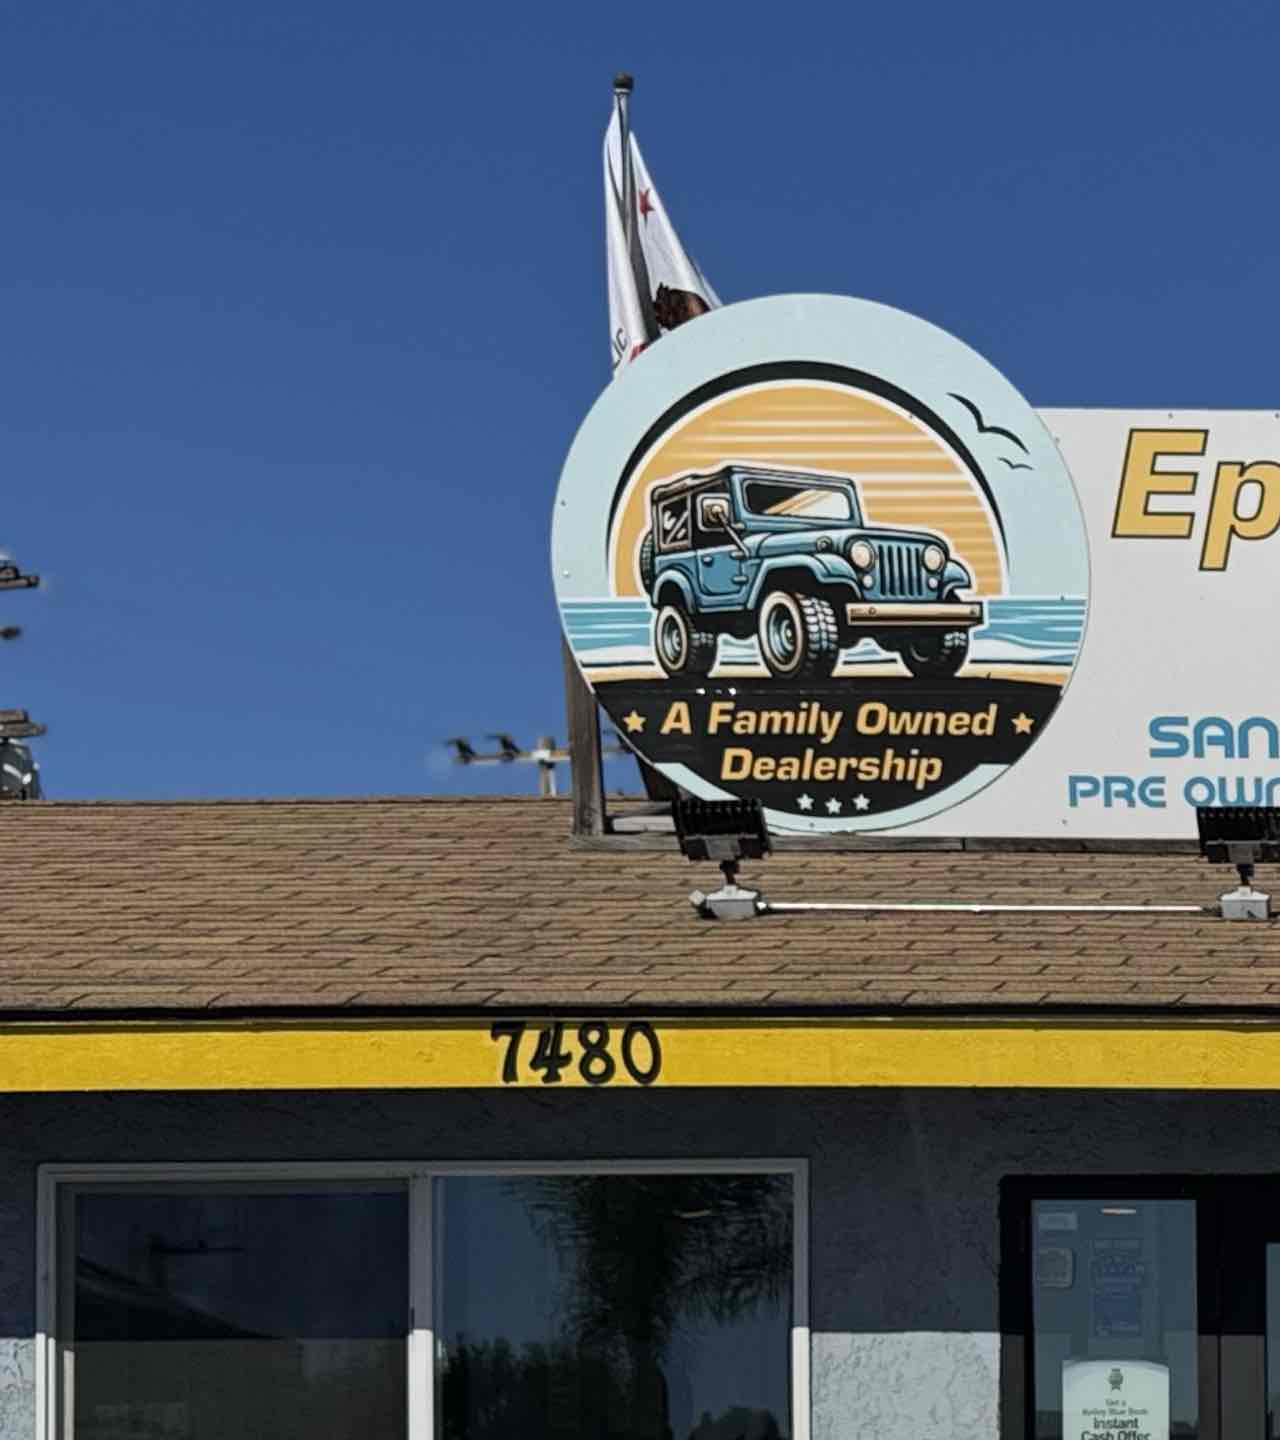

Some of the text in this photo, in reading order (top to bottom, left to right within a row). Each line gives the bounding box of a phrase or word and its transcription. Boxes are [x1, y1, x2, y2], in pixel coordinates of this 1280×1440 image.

[660, 701, 998, 745] A Family Owned
[1148, 716, 1280, 760] SAN
[720, 747, 943, 791] Dealership
[1068, 775, 1167, 809] PRE
[491, 1021, 662, 1085] 7480
[1093, 1417, 1139, 1430] Instant
